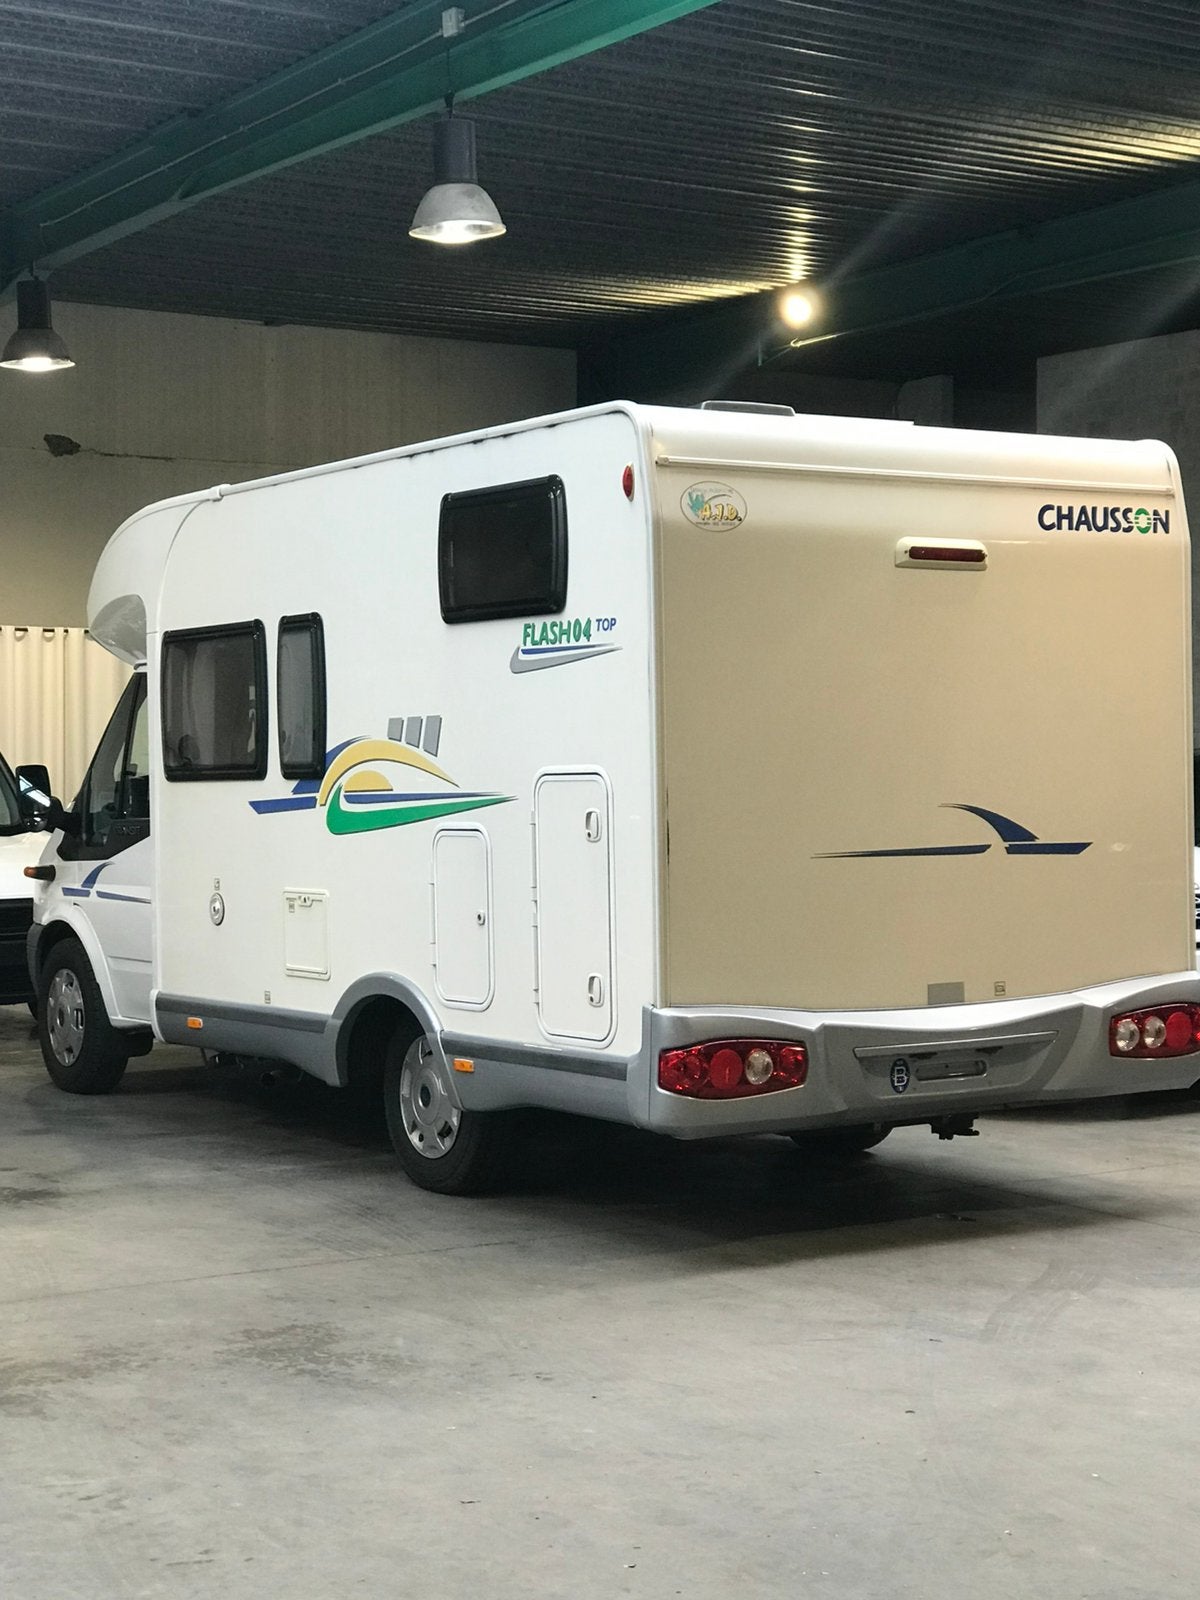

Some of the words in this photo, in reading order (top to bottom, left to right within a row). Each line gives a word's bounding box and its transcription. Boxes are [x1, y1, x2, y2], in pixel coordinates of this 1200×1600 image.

[1037, 504, 1170, 534] CHAUSSON
[596, 617, 617, 632] TOP
[894, 1066, 908, 1087] B
